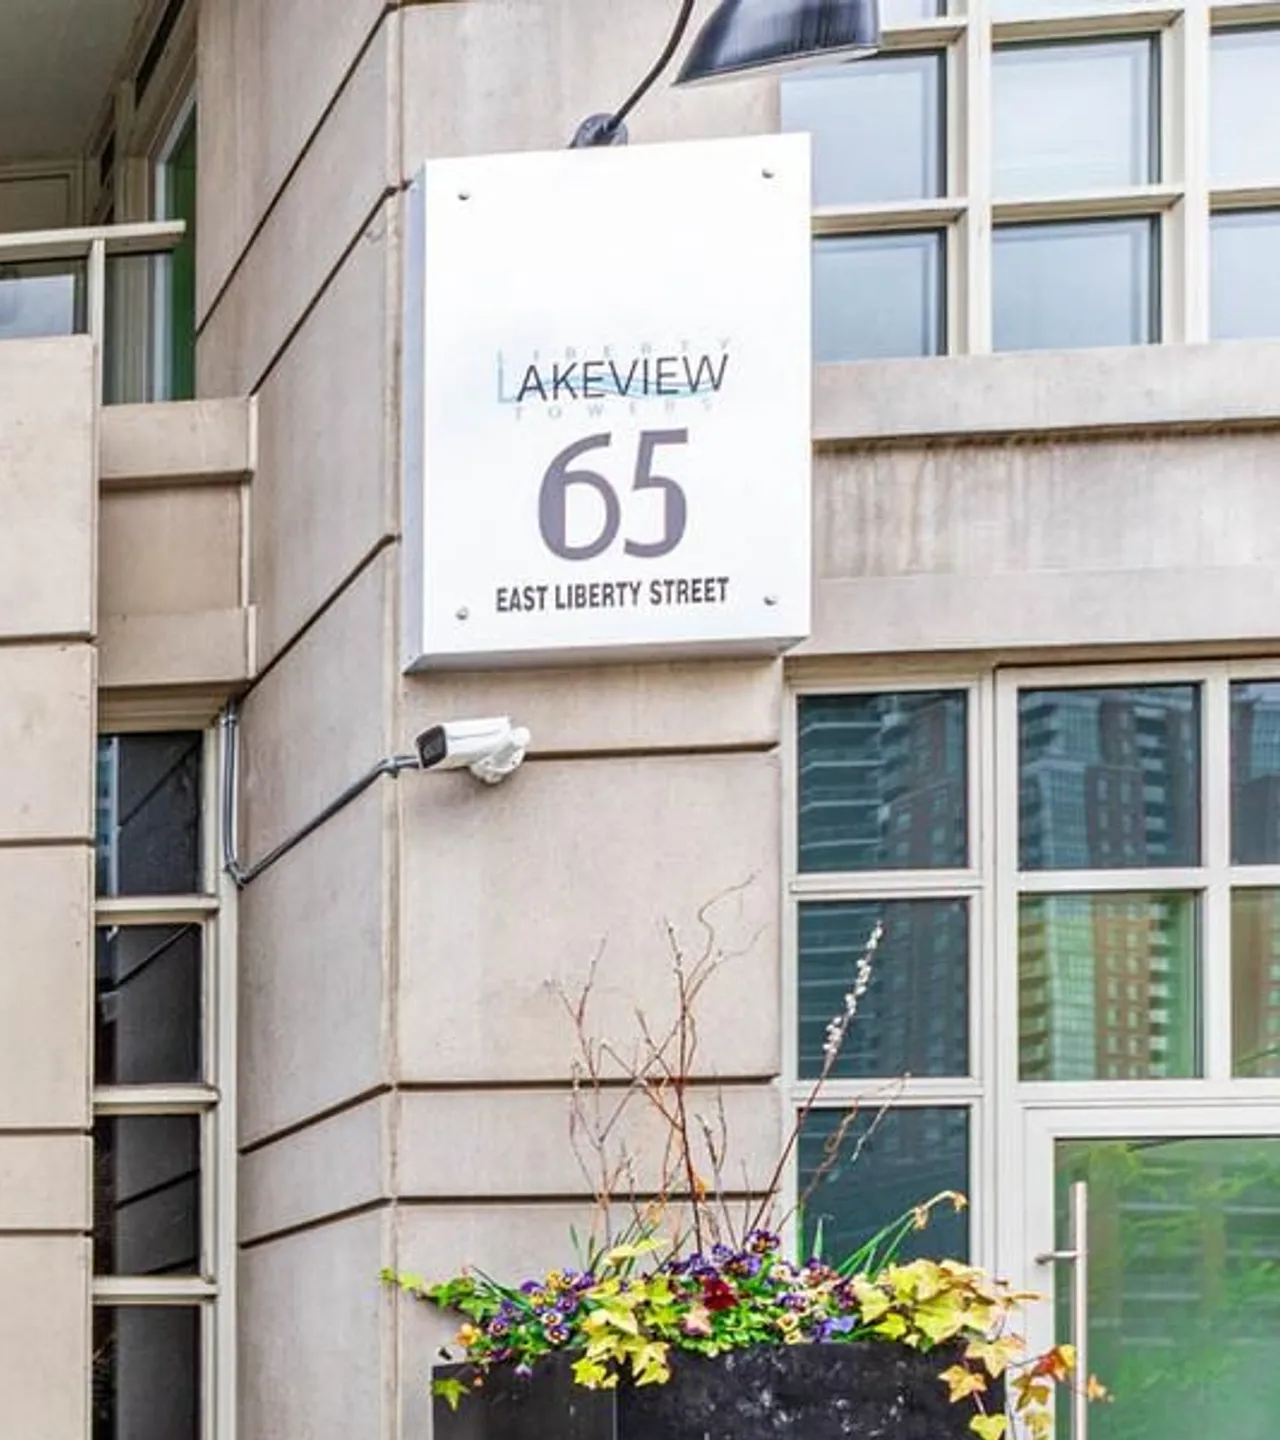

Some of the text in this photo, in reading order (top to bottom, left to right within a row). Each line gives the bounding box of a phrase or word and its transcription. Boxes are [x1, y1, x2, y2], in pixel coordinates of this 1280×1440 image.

[496, 353, 730, 404] LAKEVIEW
[537, 426, 689, 562] 65
[495, 576, 730, 613] EAST LIBERTY STREET
